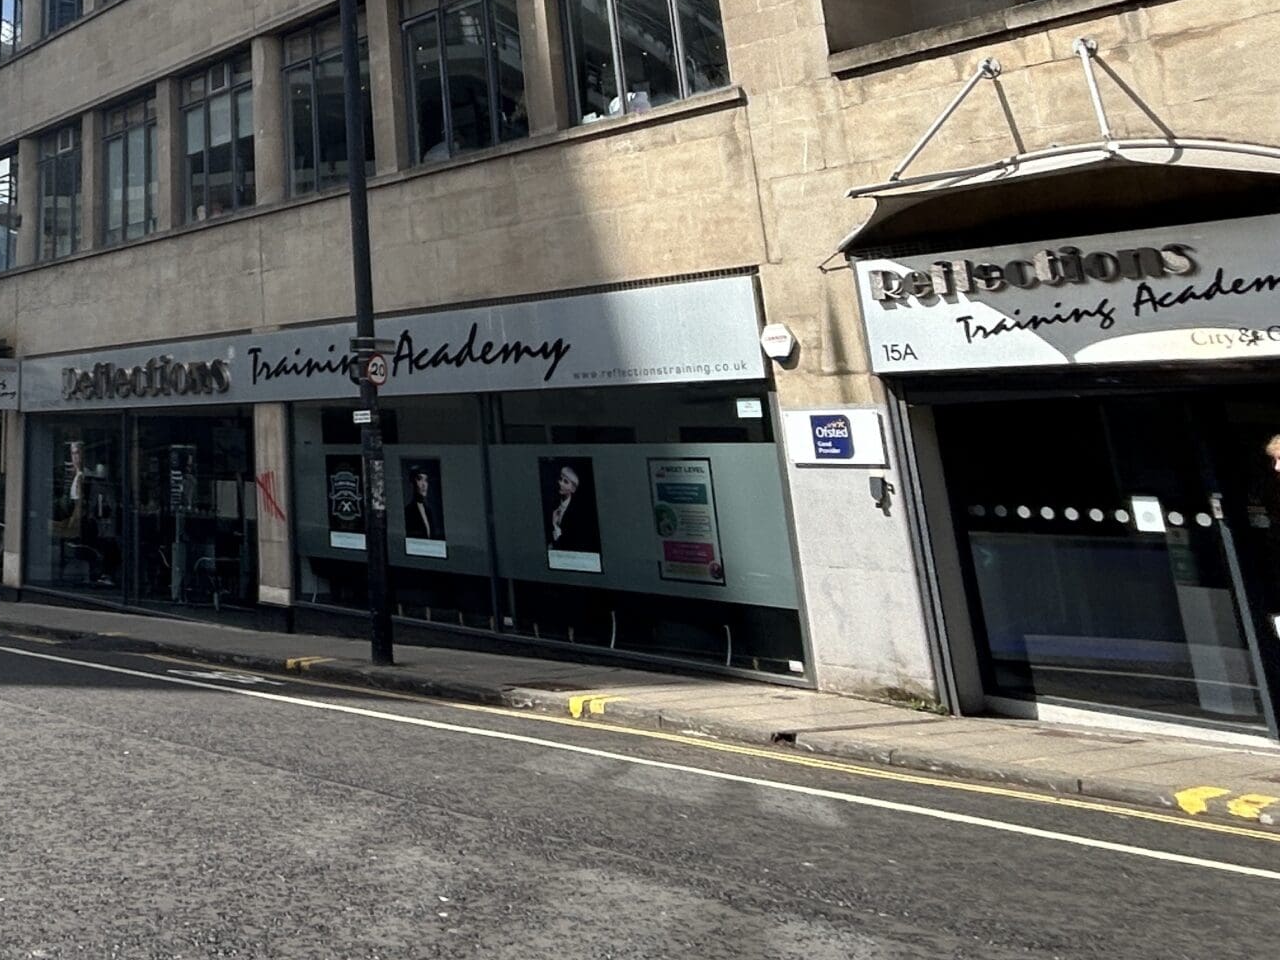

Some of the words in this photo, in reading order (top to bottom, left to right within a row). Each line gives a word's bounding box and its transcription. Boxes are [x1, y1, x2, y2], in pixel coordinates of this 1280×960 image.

[870, 244, 1199, 303] Reflections
[956, 299, 1115, 343] Training
[248, 344, 360, 385] Trainin
[393, 323, 571, 381] Academy
[882, 343, 918, 361] 15A
[370, 362, 385, 377] 20
[815, 426, 848, 438] Ofsted
